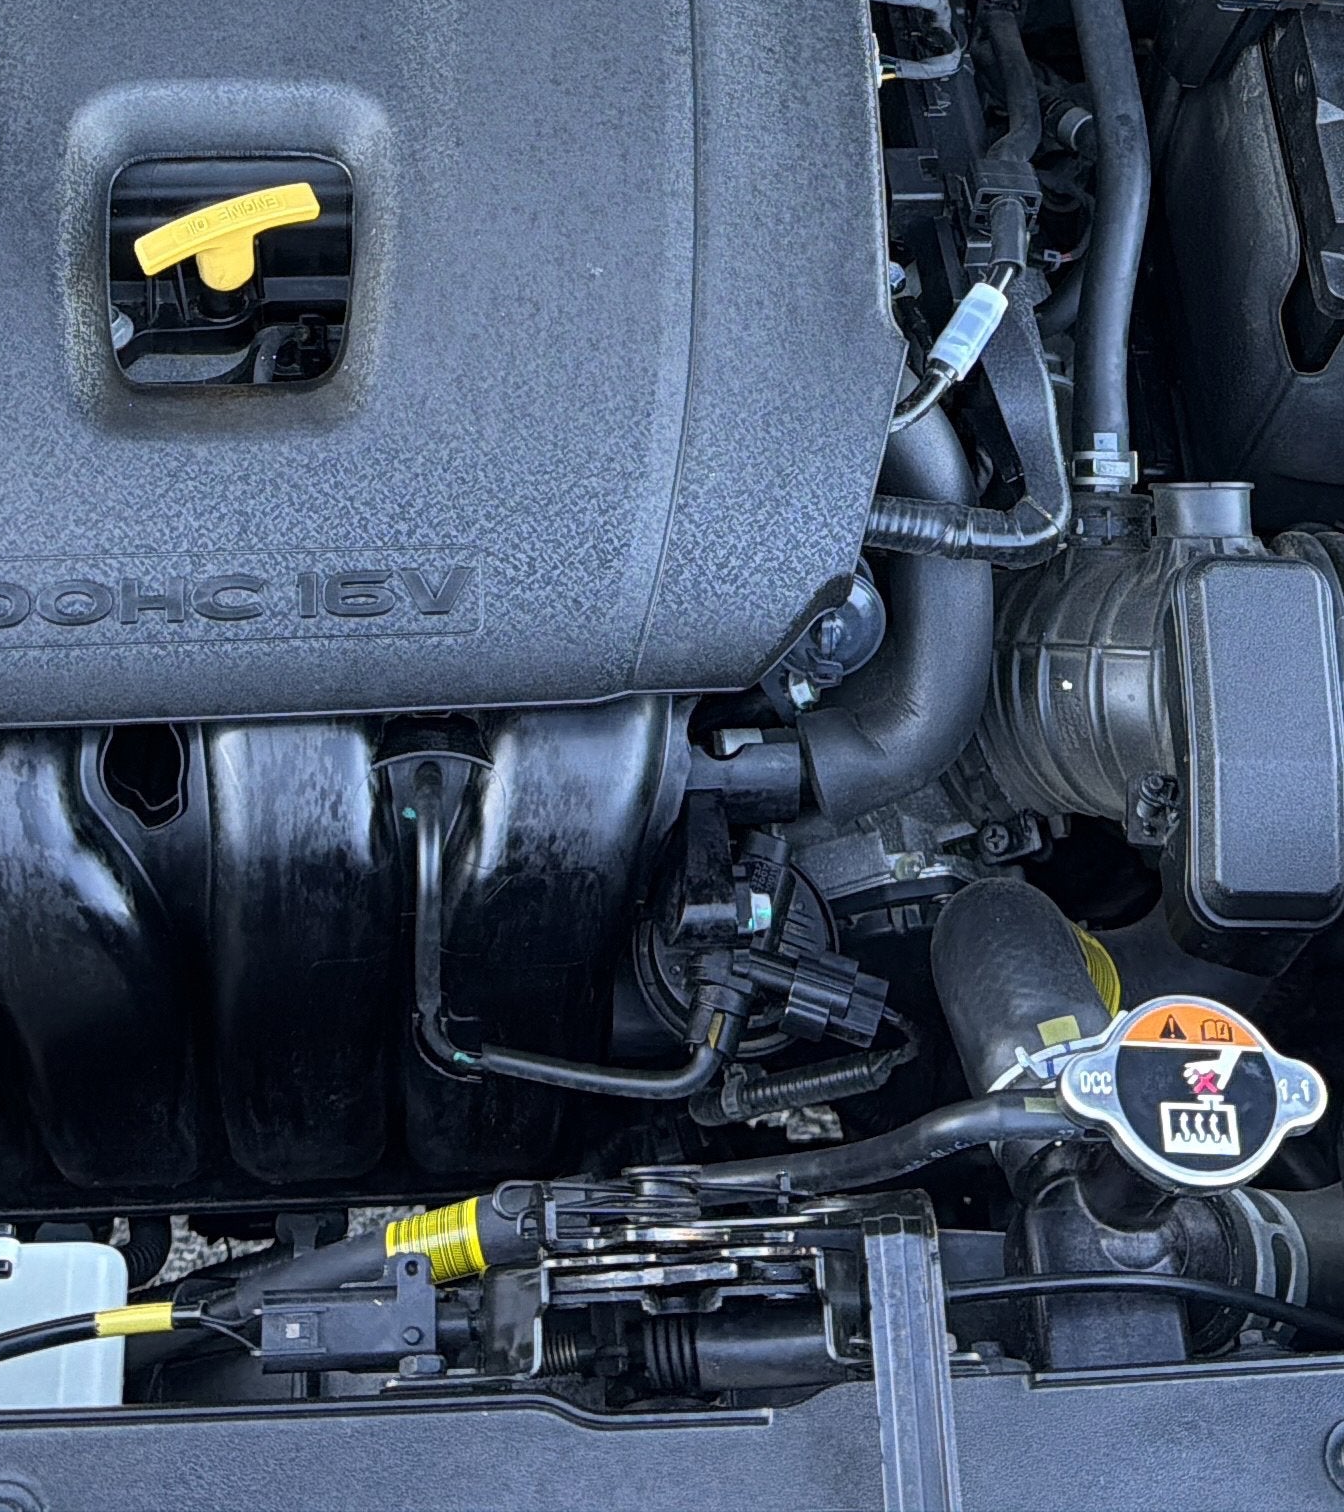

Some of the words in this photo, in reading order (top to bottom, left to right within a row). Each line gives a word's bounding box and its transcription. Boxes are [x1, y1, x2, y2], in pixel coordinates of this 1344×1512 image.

[217, 194, 279, 223] ENGINE
[185, 215, 209, 235] OIL
[293, 566, 473, 619] 16V
